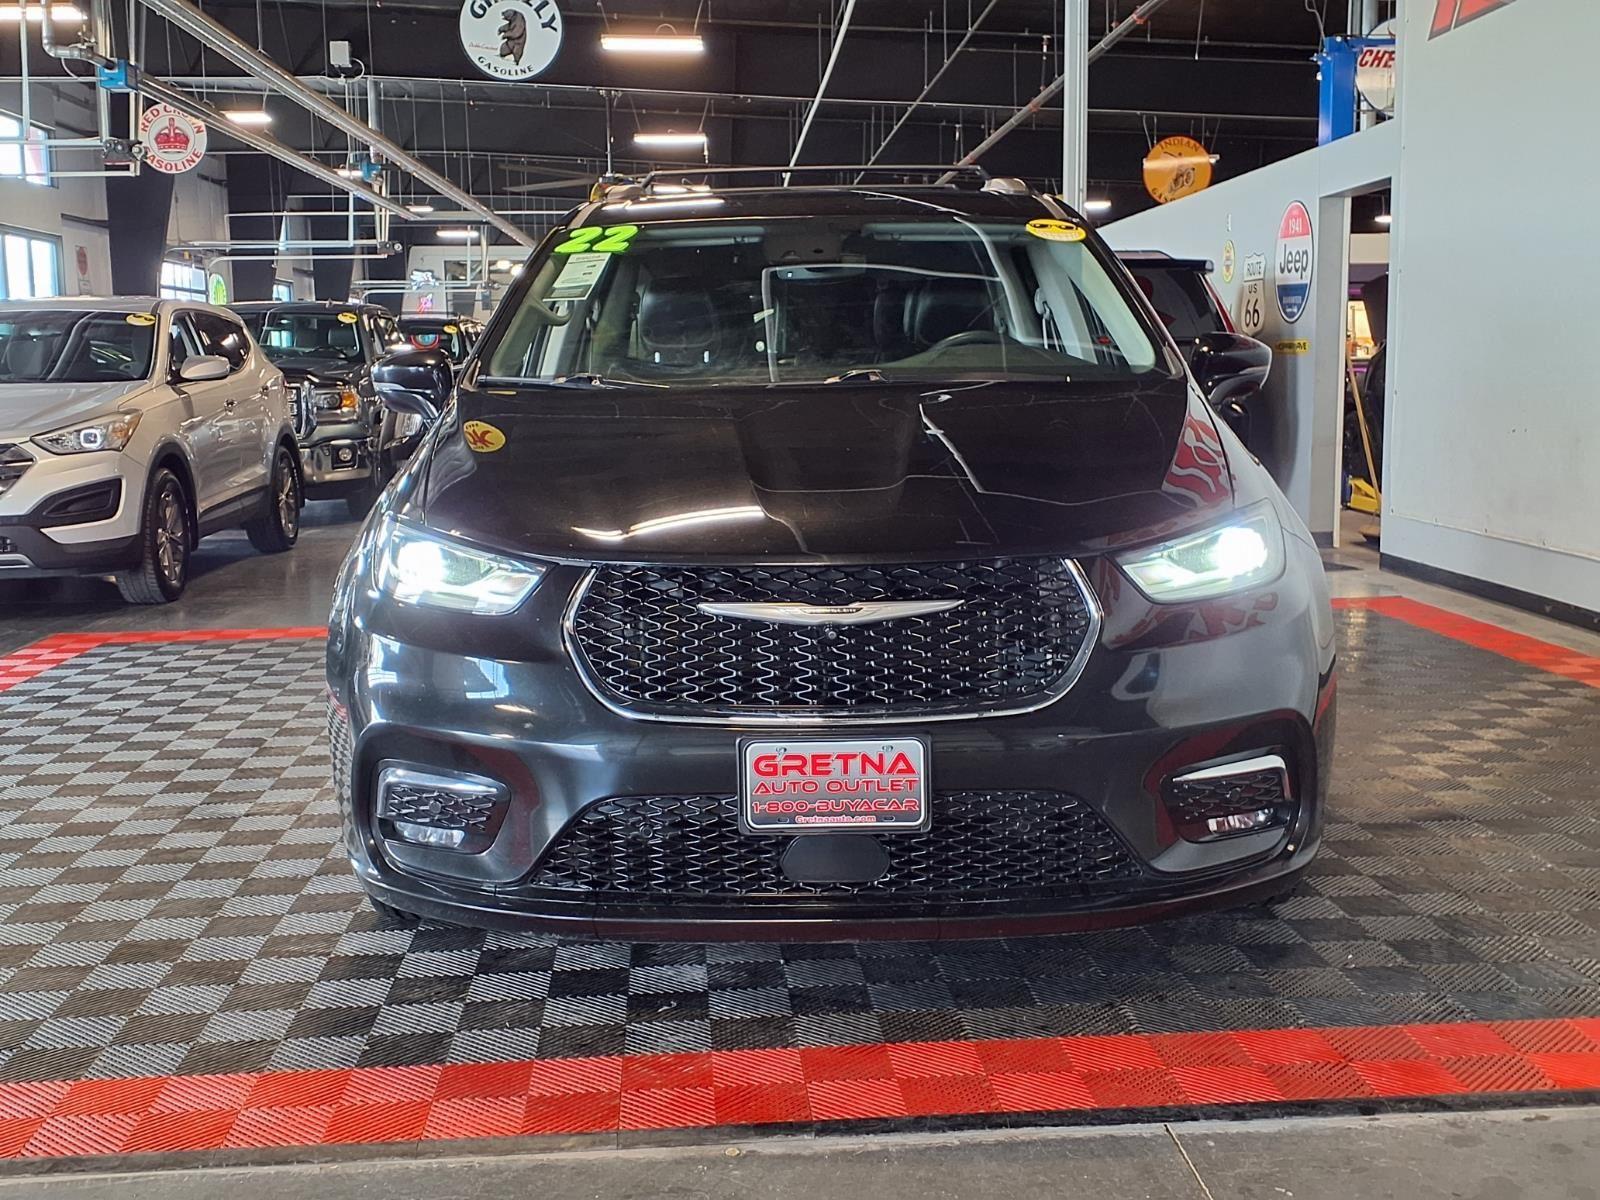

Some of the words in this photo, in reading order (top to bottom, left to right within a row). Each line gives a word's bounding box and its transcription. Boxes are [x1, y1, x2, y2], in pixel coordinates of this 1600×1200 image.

[478, 56, 534, 76] GASOLINE
[141, 108, 160, 132] RED
[1159, 138, 1200, 152] INDIAN
[1288, 218, 1303, 234] 1941
[553, 225, 640, 253] 22
[1246, 261, 1262, 277] ROUTE
[1279, 243, 1309, 280] Jeep
[1247, 283, 1258, 294] US
[1244, 298, 1260, 328] 66
[754, 752, 917, 776] GRETNA
[753, 780, 819, 794] AUTO
[826, 779, 919, 792] OUTLET
[752, 799, 919, 813] 1-800-BUYACAR
[796, 814, 877, 823] Gretnaauto.com
